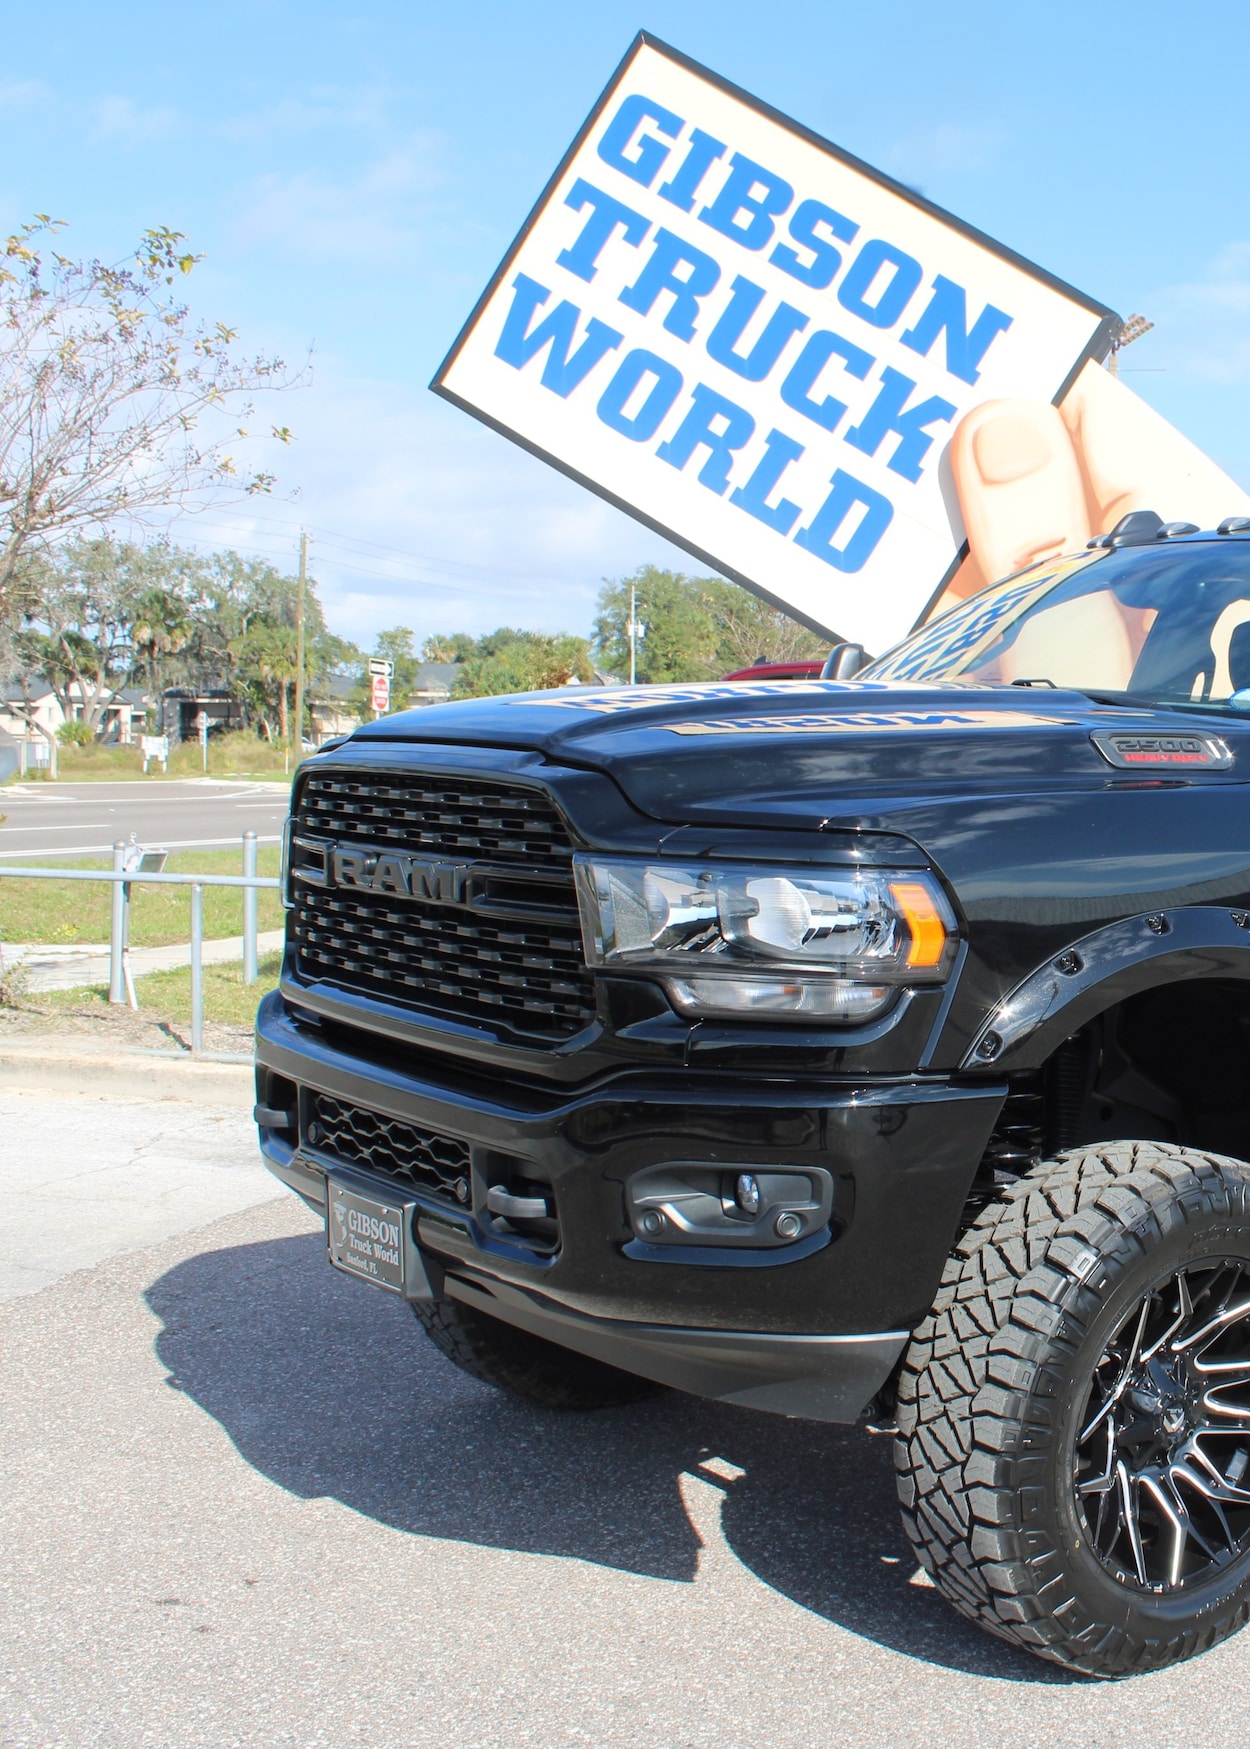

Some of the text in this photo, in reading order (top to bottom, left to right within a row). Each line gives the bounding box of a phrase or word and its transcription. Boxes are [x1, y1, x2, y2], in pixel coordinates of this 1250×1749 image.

[597, 94, 1013, 386] GIBSON
[556, 178, 957, 484] TRUCK
[494, 273, 894, 574] WORLD
[1115, 739, 1202, 753] 2500
[1124, 754, 1209, 763] HEAVY DUTY
[334, 848, 464, 903] RAM
[348, 1209, 399, 1247] GIBSON
[349, 1233, 399, 1266] Truck World
[369, 1262, 378, 1275] FL
